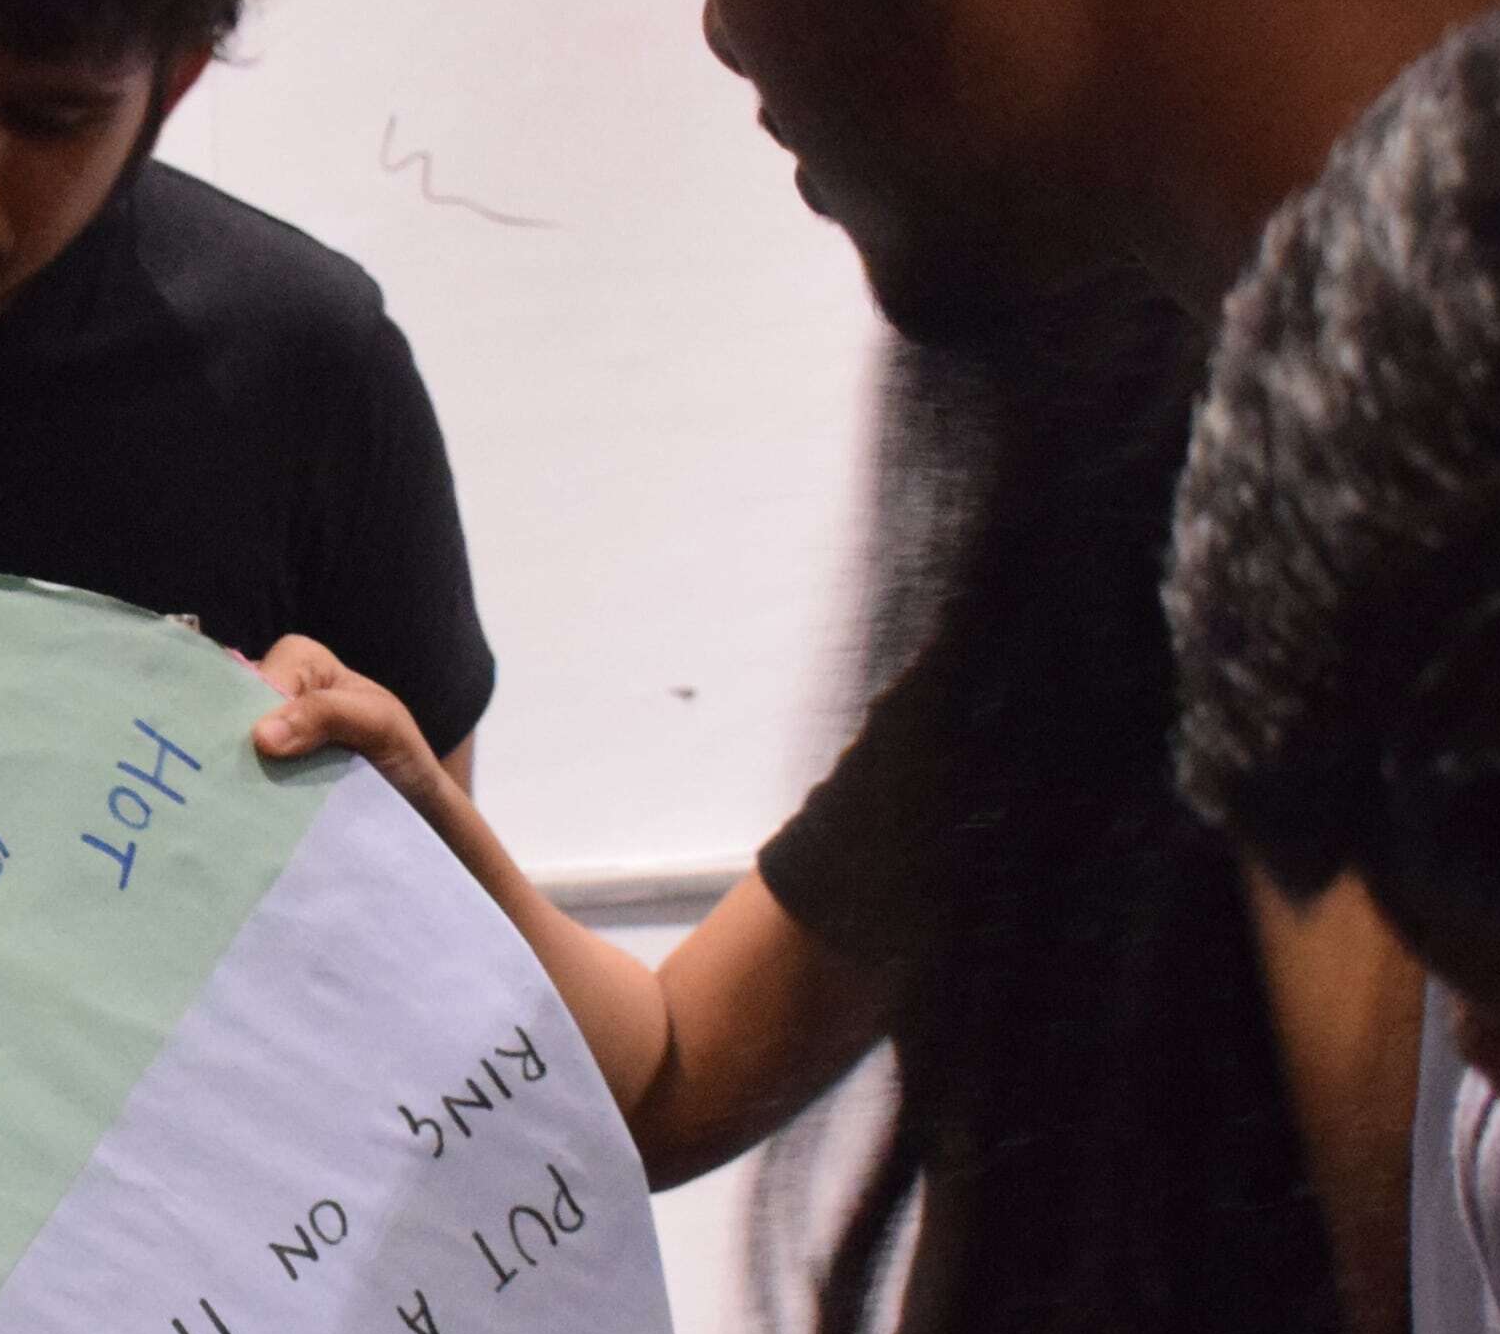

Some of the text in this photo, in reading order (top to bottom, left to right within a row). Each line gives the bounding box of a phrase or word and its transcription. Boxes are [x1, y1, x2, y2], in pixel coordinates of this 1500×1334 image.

[81, 719, 202, 891] HOT
[397, 1026, 546, 1159] RING
[268, 1199, 347, 1281] ON
[472, 1164, 585, 1292] PUT
